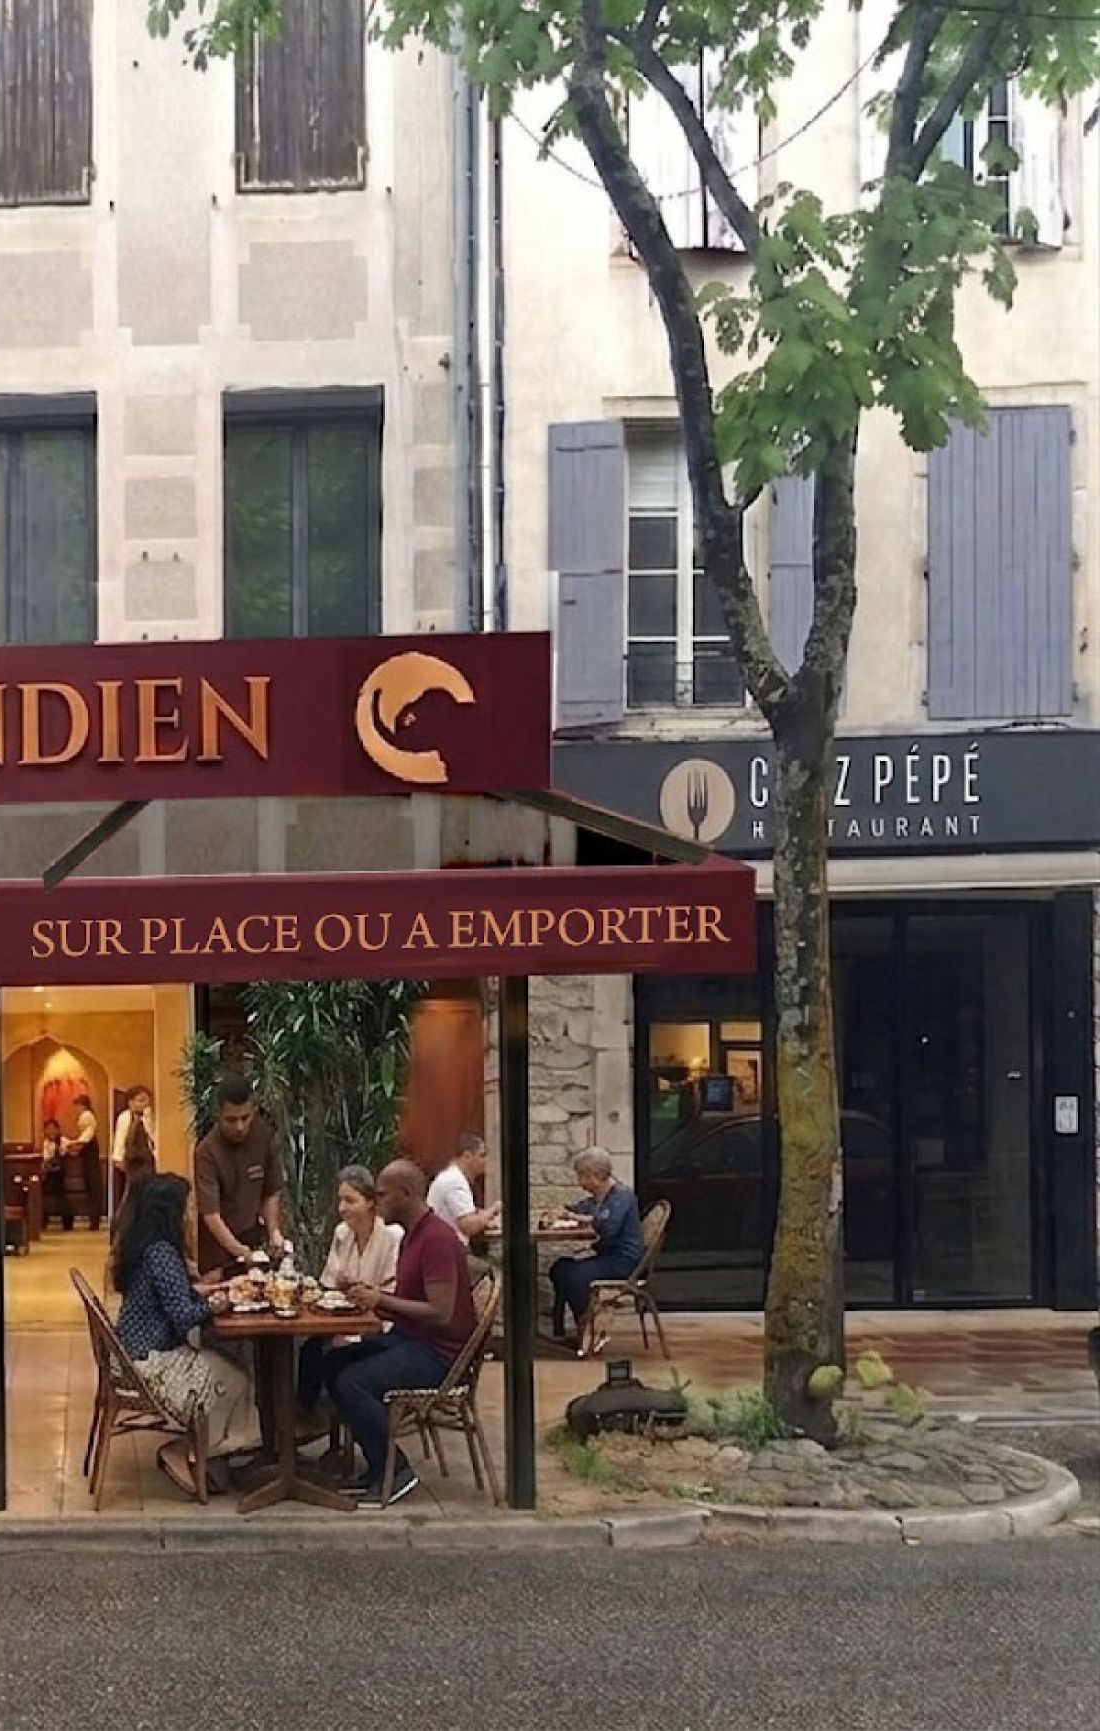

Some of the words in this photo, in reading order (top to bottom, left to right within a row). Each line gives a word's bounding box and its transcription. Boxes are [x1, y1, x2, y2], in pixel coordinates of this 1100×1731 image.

[749, 755, 852, 807] CZ
[873, 742, 981, 805] PÉPÉ
[30, 918, 132, 958] SUR
[139, 914, 302, 955] PLACE
[313, 912, 394, 953] OU
[401, 911, 440, 950] A
[448, 904, 732, 949] EMPORTER
